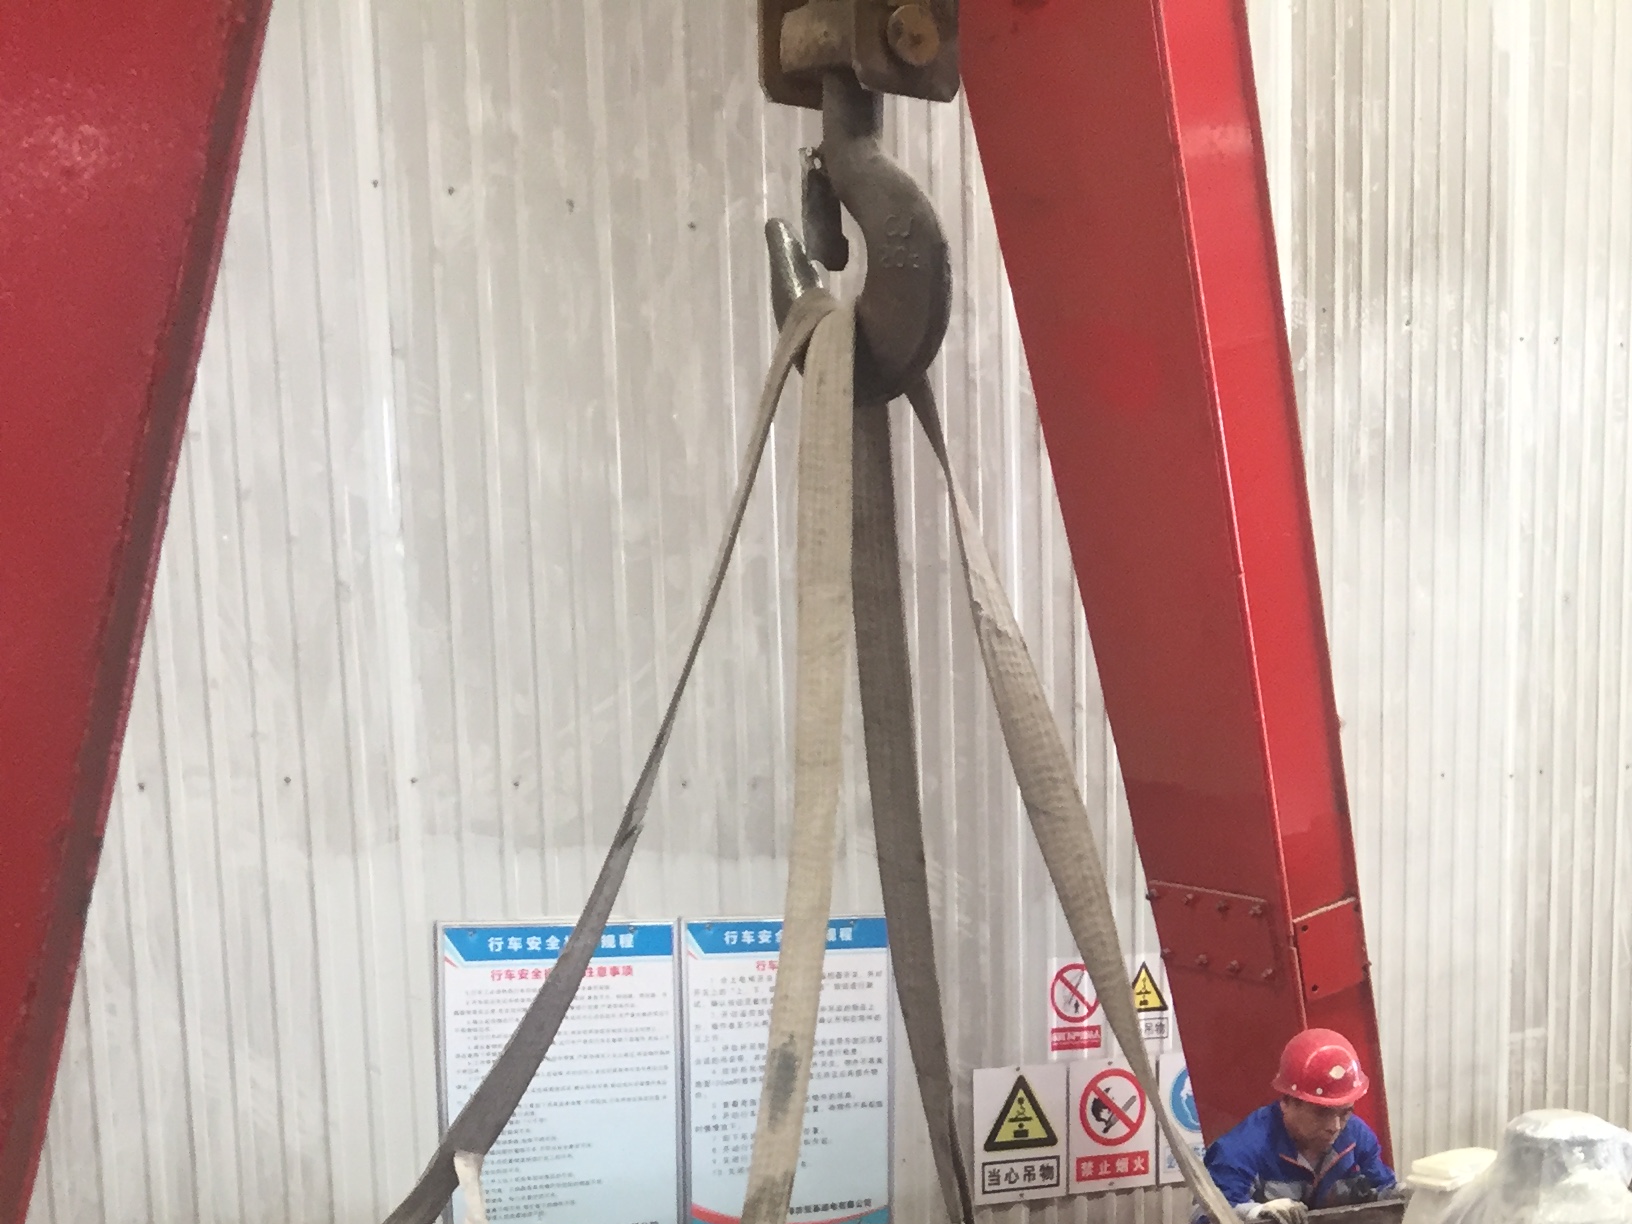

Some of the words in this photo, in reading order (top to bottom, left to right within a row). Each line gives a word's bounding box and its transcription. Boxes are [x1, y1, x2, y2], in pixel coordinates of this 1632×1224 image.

[487, 932, 636, 954] 行车安全规程
[723, 926, 853, 946] 行车安全规程
[987, 1164, 1056, 1187] 当心吊物
[1080, 1156, 1146, 1177] 禁止烟火
